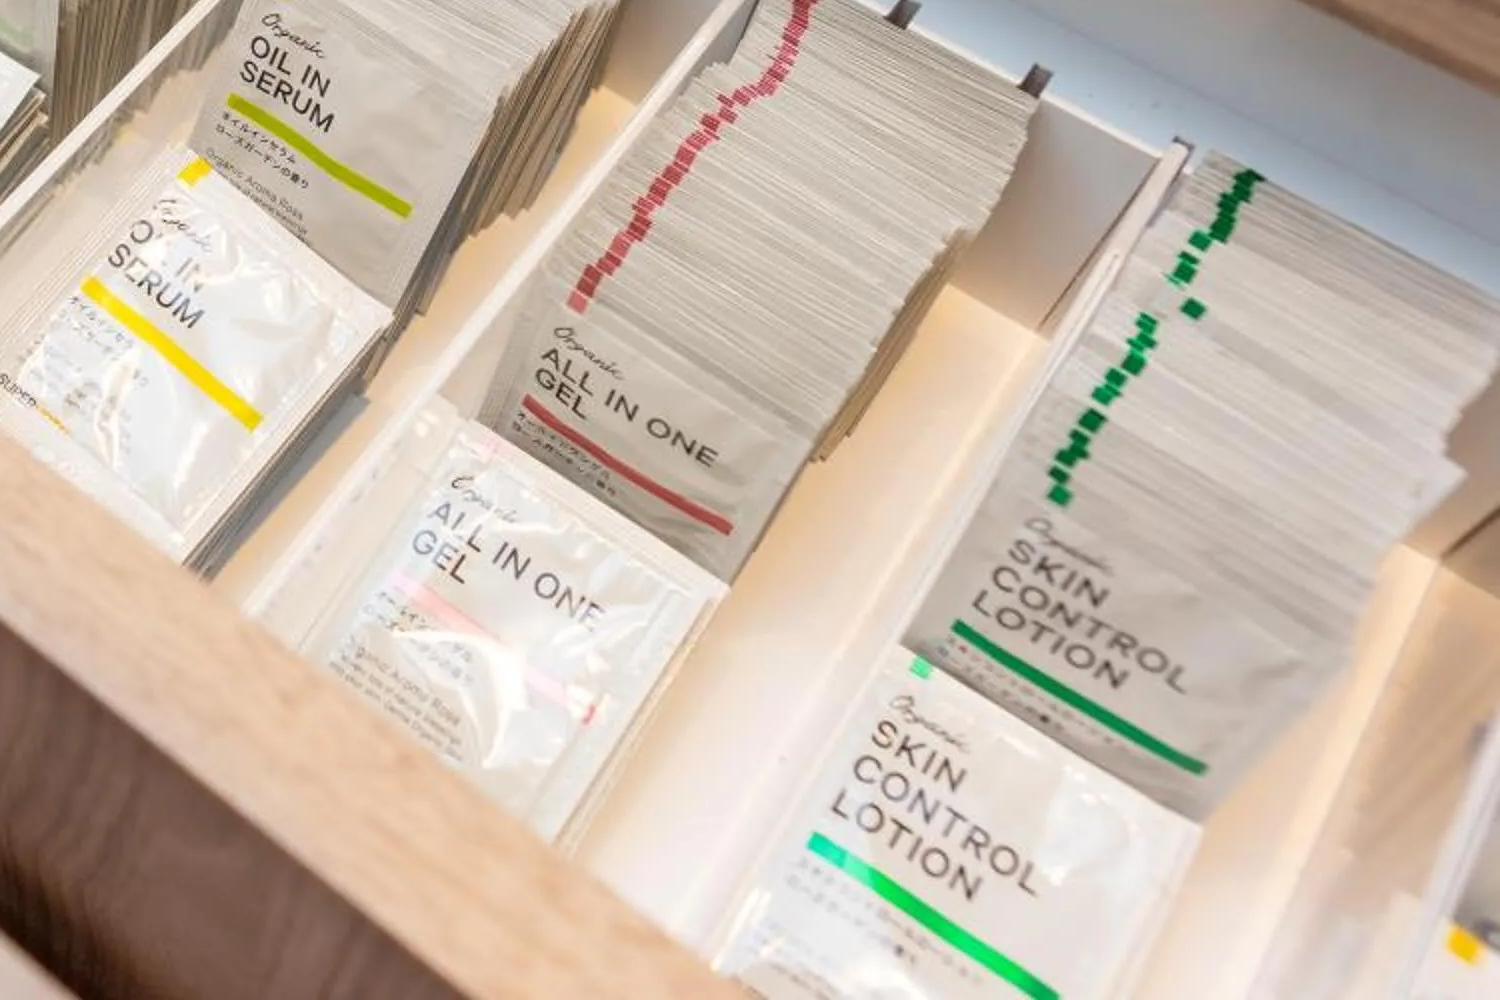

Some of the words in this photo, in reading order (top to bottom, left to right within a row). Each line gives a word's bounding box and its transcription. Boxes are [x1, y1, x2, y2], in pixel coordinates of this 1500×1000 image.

[250, 36, 293, 77] OIL
[302, 64, 332, 96] IN
[261, 12, 324, 59] Organic
[240, 60, 336, 133] SERUM
[108, 244, 204, 329] SERUM
[554, 327, 625, 381] Organic
[535, 368, 590, 420] GEL
[541, 348, 593, 397] ALL
[604, 388, 640, 423] IN
[646, 414, 719, 468] ONE
[411, 530, 466, 584] GEL
[429, 502, 483, 552] ALL
[492, 542, 531, 580] IN
[533, 571, 604, 631] ONE
[1008, 539, 1110, 608] SKIN
[1026, 517, 1116, 576] Organic
[972, 590, 1130, 691] LOTION
[991, 565, 1188, 695] CONTROL
[871, 720, 967, 794] SKIN
[889, 695, 972, 755] Organic
[831, 790, 984, 902] LOTION
[854, 755, 1040, 899] CONTROL
